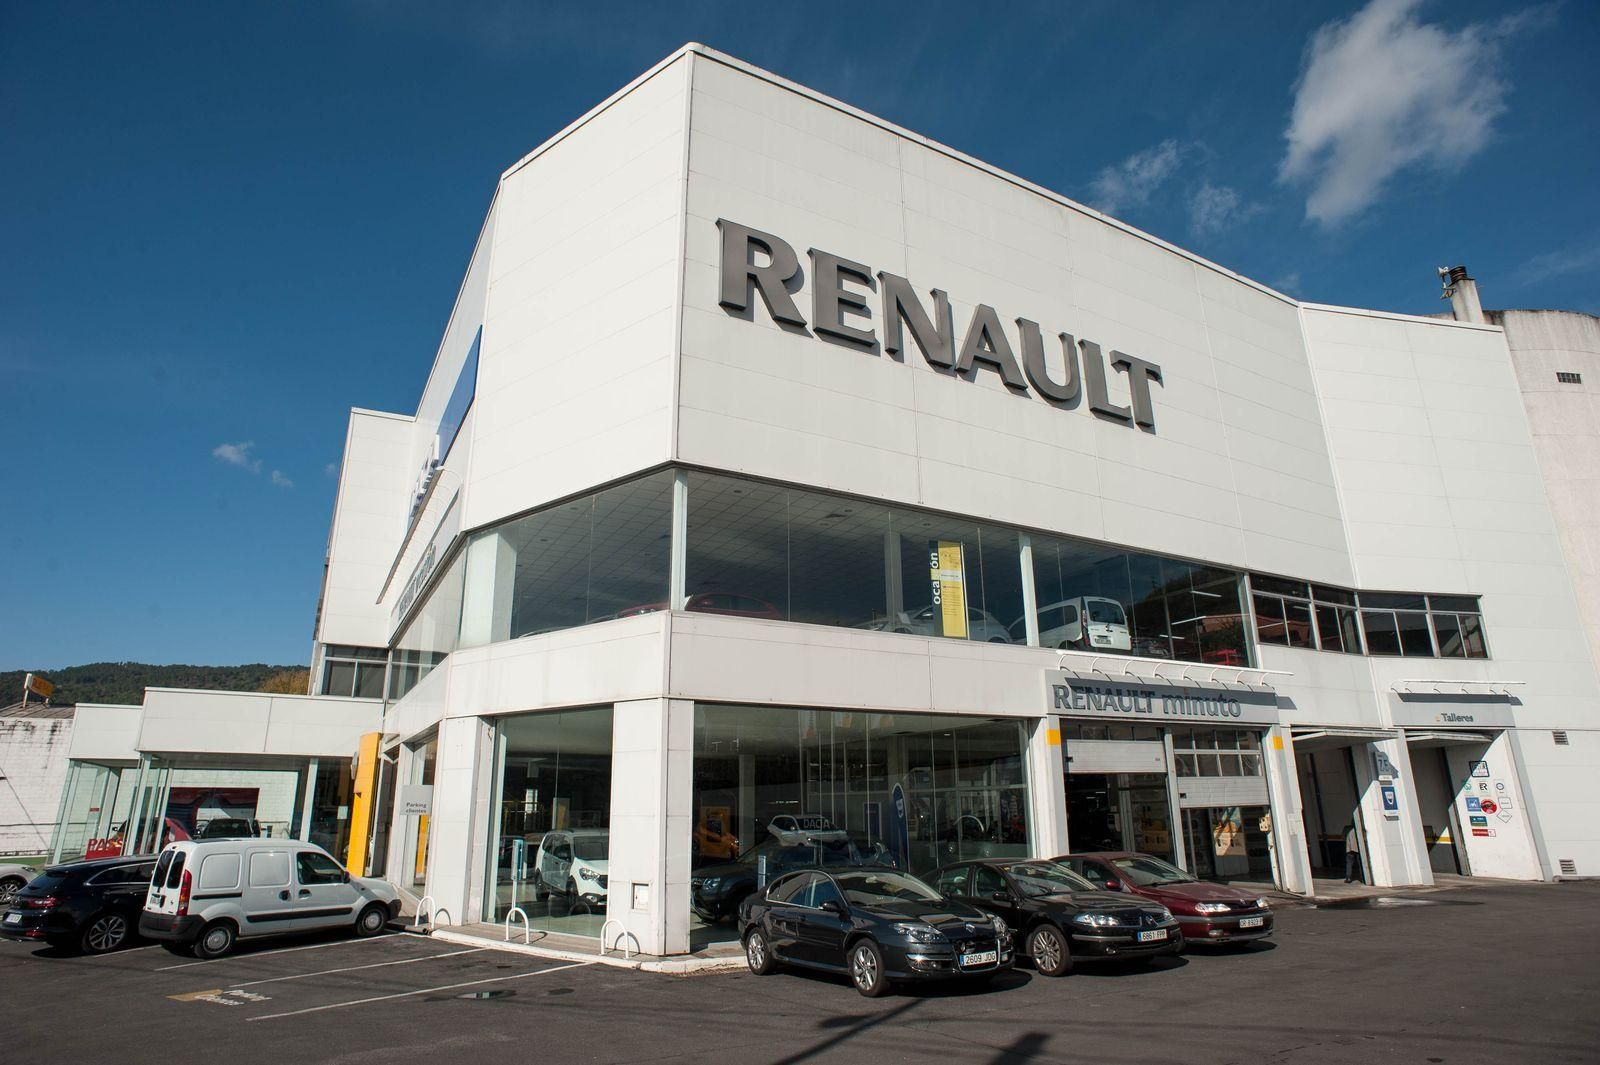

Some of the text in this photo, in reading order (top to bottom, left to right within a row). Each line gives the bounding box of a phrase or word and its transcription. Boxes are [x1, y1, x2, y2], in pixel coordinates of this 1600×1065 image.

[715, 217, 1162, 431] RENAULT
[930, 552, 941, 605] ocaón
[1053, 684, 1243, 717] RENAULT minuto
[1440, 712, 1474, 722] Talleres
[965, 954, 982, 965] 2609
